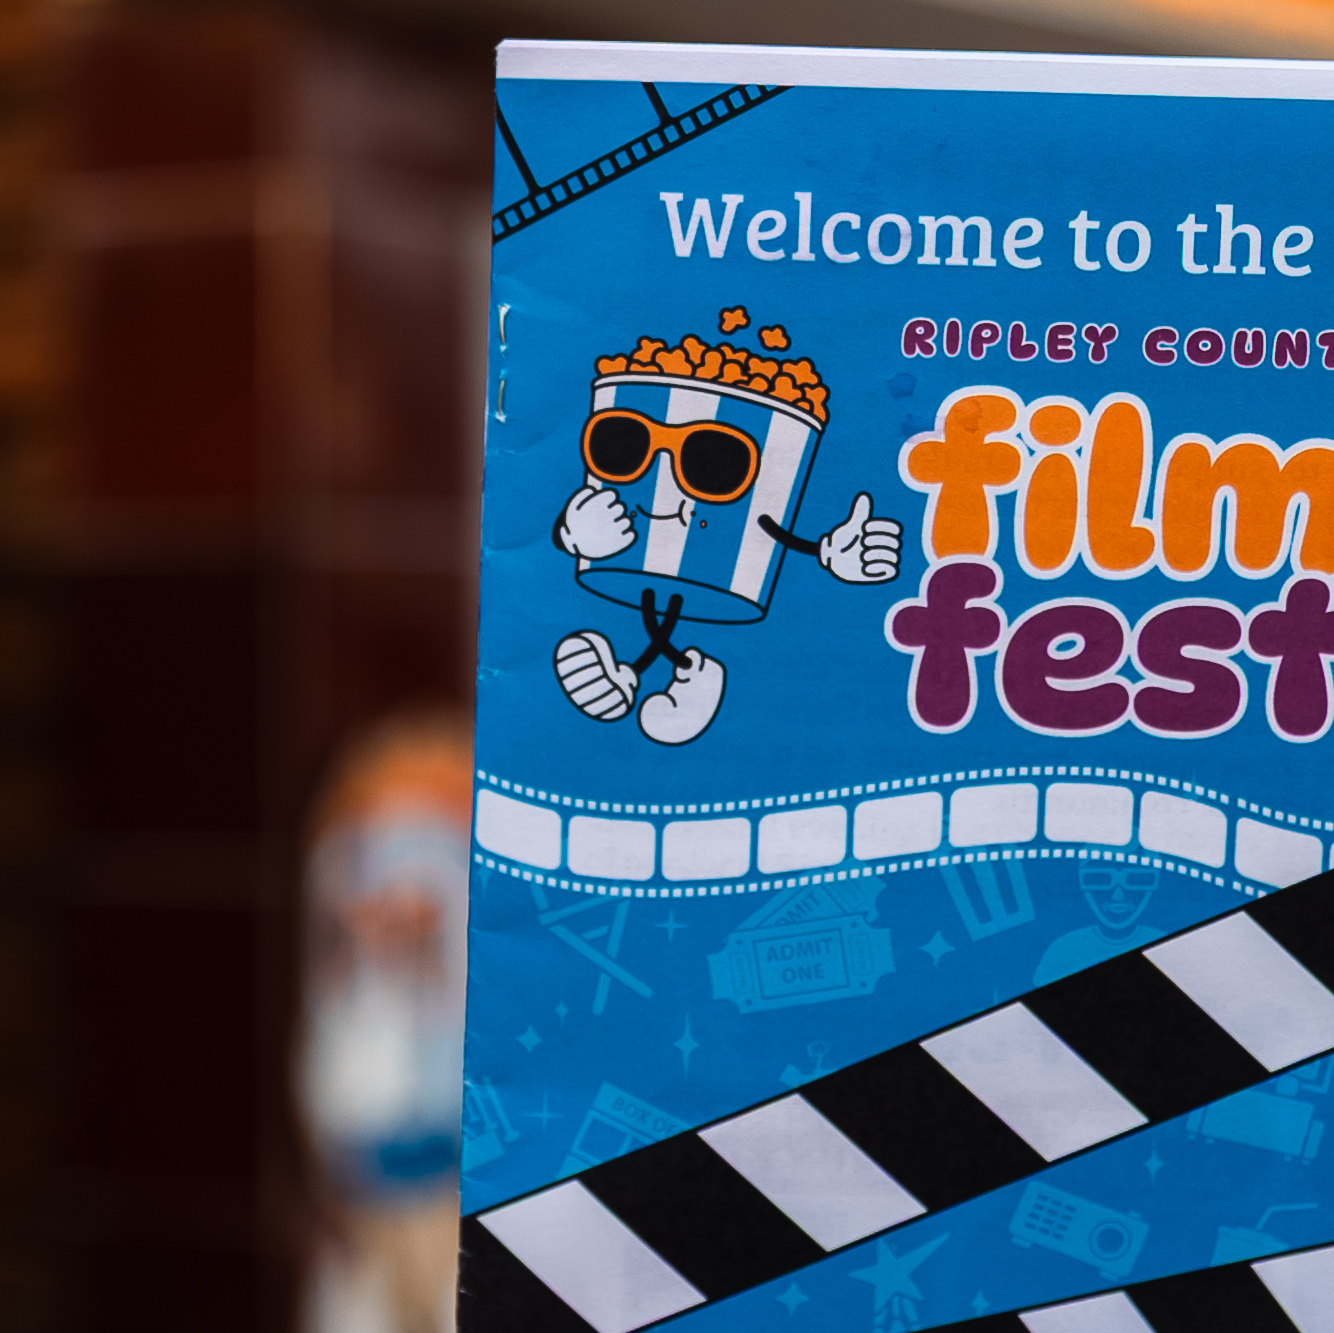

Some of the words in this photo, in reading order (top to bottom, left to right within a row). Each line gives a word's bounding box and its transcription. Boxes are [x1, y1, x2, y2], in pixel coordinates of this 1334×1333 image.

[658, 190, 1045, 270] Welcome
[1067, 209, 1153, 273] to
[1175, 203, 1315, 278] the
[901, 317, 1118, 364] RIPLEY
[766, 937, 834, 964] ADMIT
[781, 962, 826, 985] ONE
[611, 1095, 652, 1125] BOX
